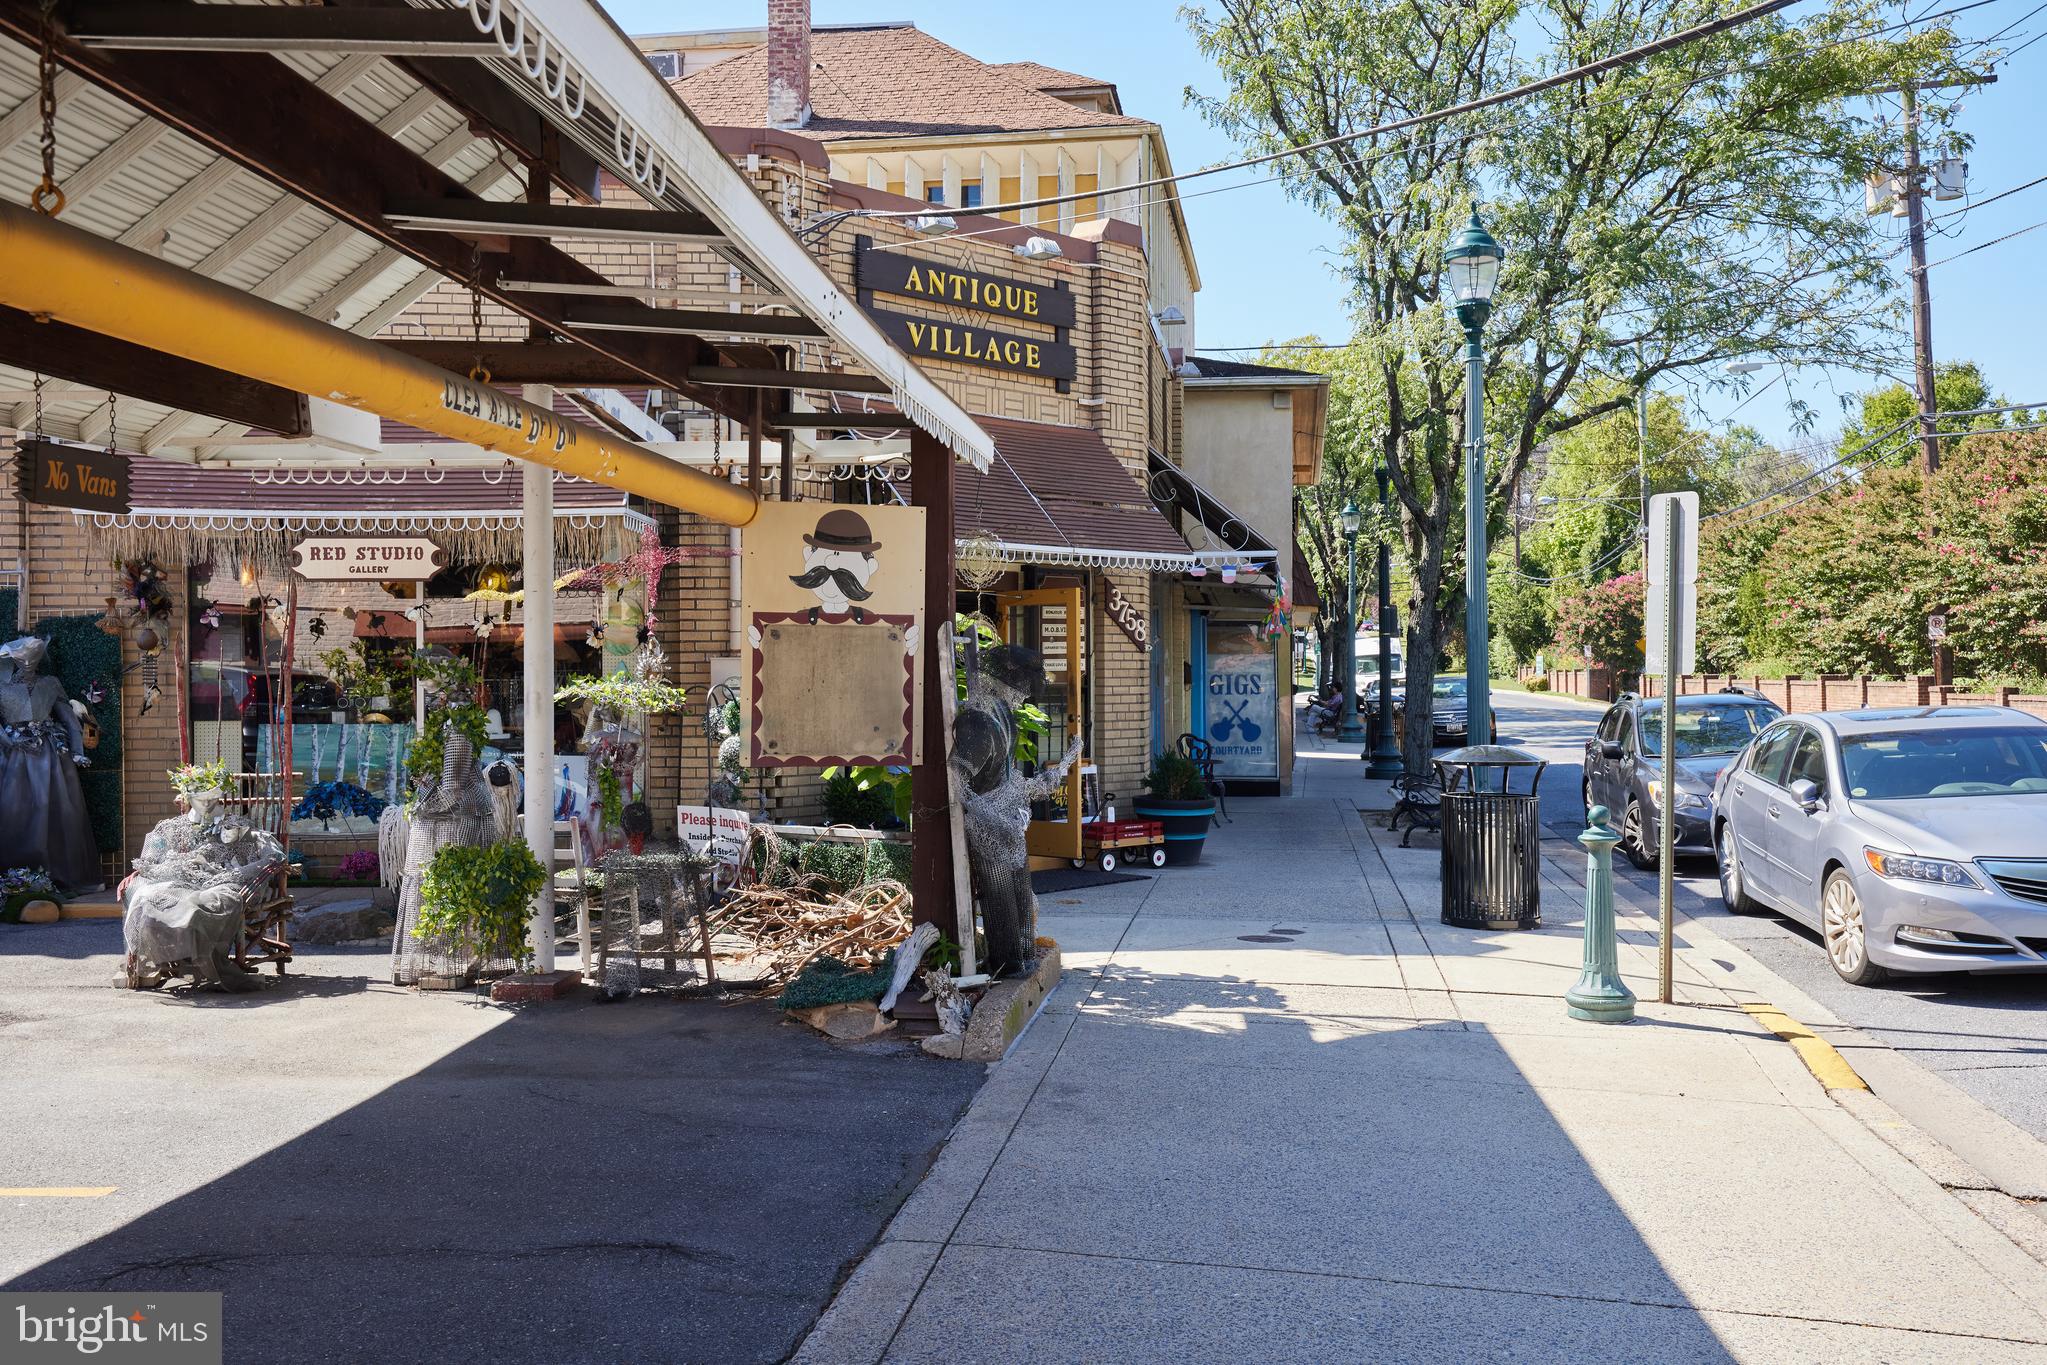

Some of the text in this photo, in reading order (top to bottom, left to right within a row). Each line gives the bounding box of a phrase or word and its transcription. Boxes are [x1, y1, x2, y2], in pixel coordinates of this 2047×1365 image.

[905, 265, 1039, 316] ANTIQUE
[906, 321, 1041, 369] VILLAGE
[44, 459, 118, 498] No Vans
[310, 546, 425, 561] RED STUDIO
[348, 565, 390, 574] GALLERY
[1109, 588, 1146, 641] 3758
[1210, 674, 1262, 696] GIGS
[1210, 745, 1263, 756] COURTYARD
[681, 812, 748, 832] Please inquire
[688, 832, 711, 841] Inside
